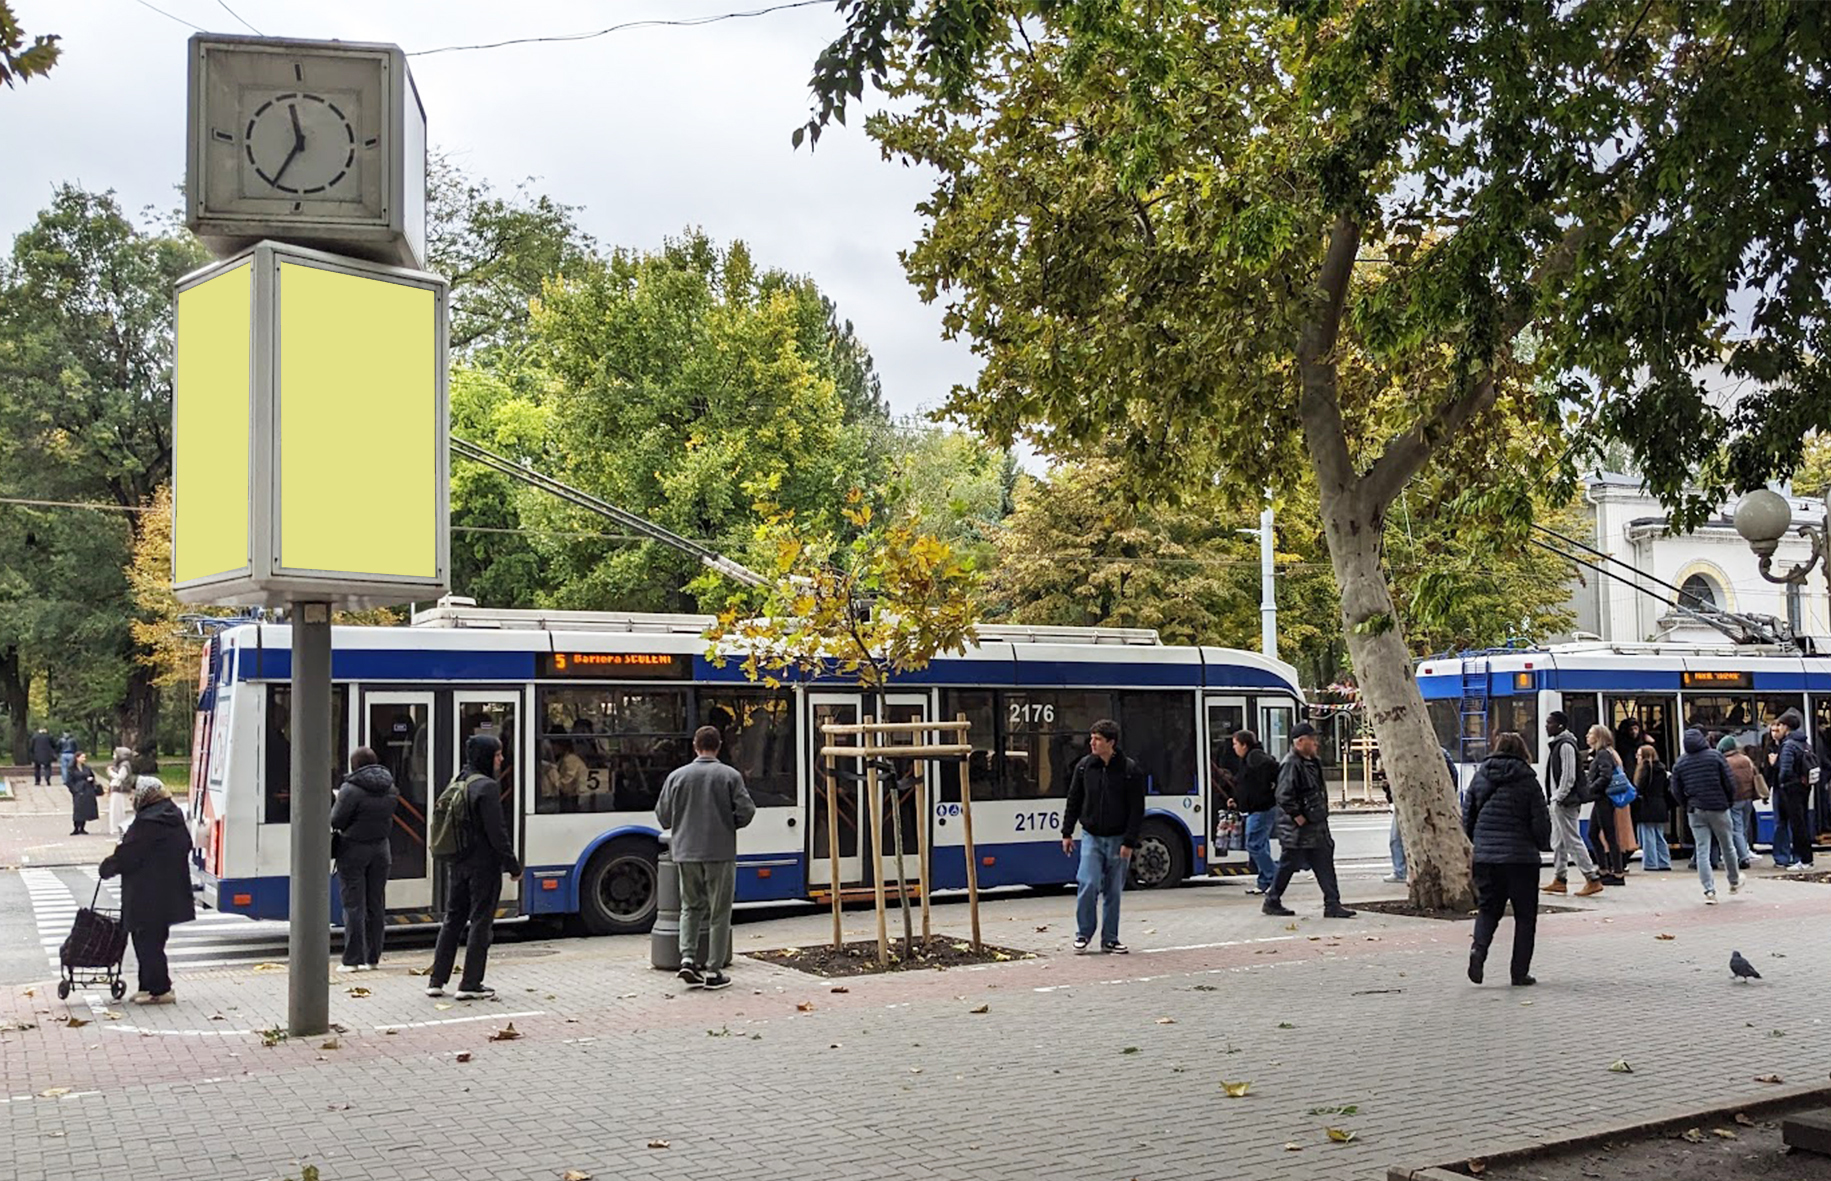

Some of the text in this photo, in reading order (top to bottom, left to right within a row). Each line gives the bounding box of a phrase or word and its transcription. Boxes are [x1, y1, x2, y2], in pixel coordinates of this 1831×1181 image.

[555, 653, 567, 669] 5
[624, 654, 672, 664] SCULENI
[1009, 703, 1055, 723] 2176
[586, 770, 600, 790] 5
[1014, 811, 1060, 832] 2176
